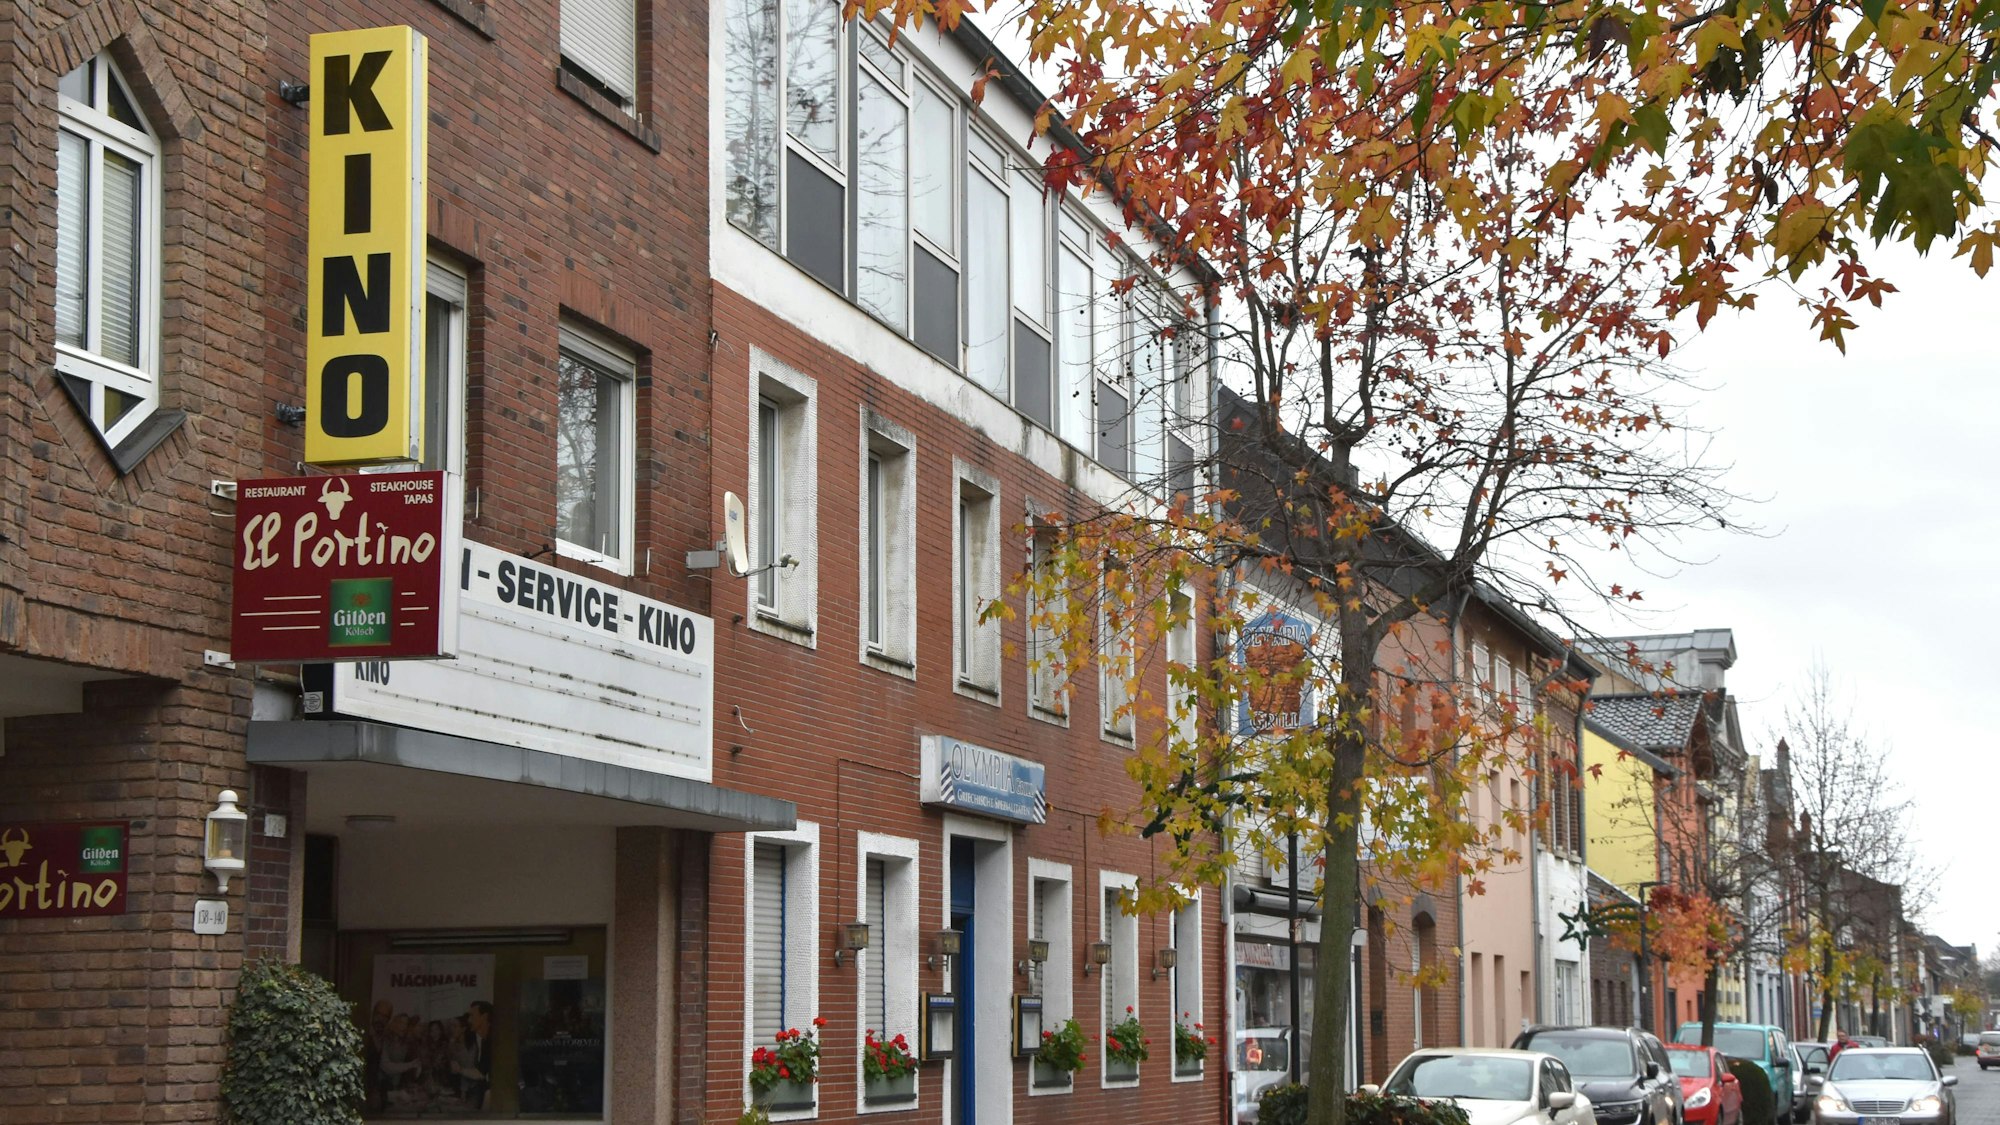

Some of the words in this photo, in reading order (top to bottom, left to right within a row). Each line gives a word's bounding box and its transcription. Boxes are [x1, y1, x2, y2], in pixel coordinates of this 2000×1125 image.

[320, 50, 394, 438] KINO
[245, 486, 306, 498] RESTAURANT
[370, 480, 434, 492] STEAKHOUSE
[404, 494, 434, 504] TAPAS
[243, 512, 281, 570] El
[293, 512, 435, 568] Portino
[334, 609, 386, 627] Gilden
[345, 626, 374, 636] Kölsch
[952, 743, 1015, 793] OLYMPIA
[83, 848, 119, 860] Gilden
[0, 860, 118, 911] ortino
[391, 973, 477, 987] NACHNAME
